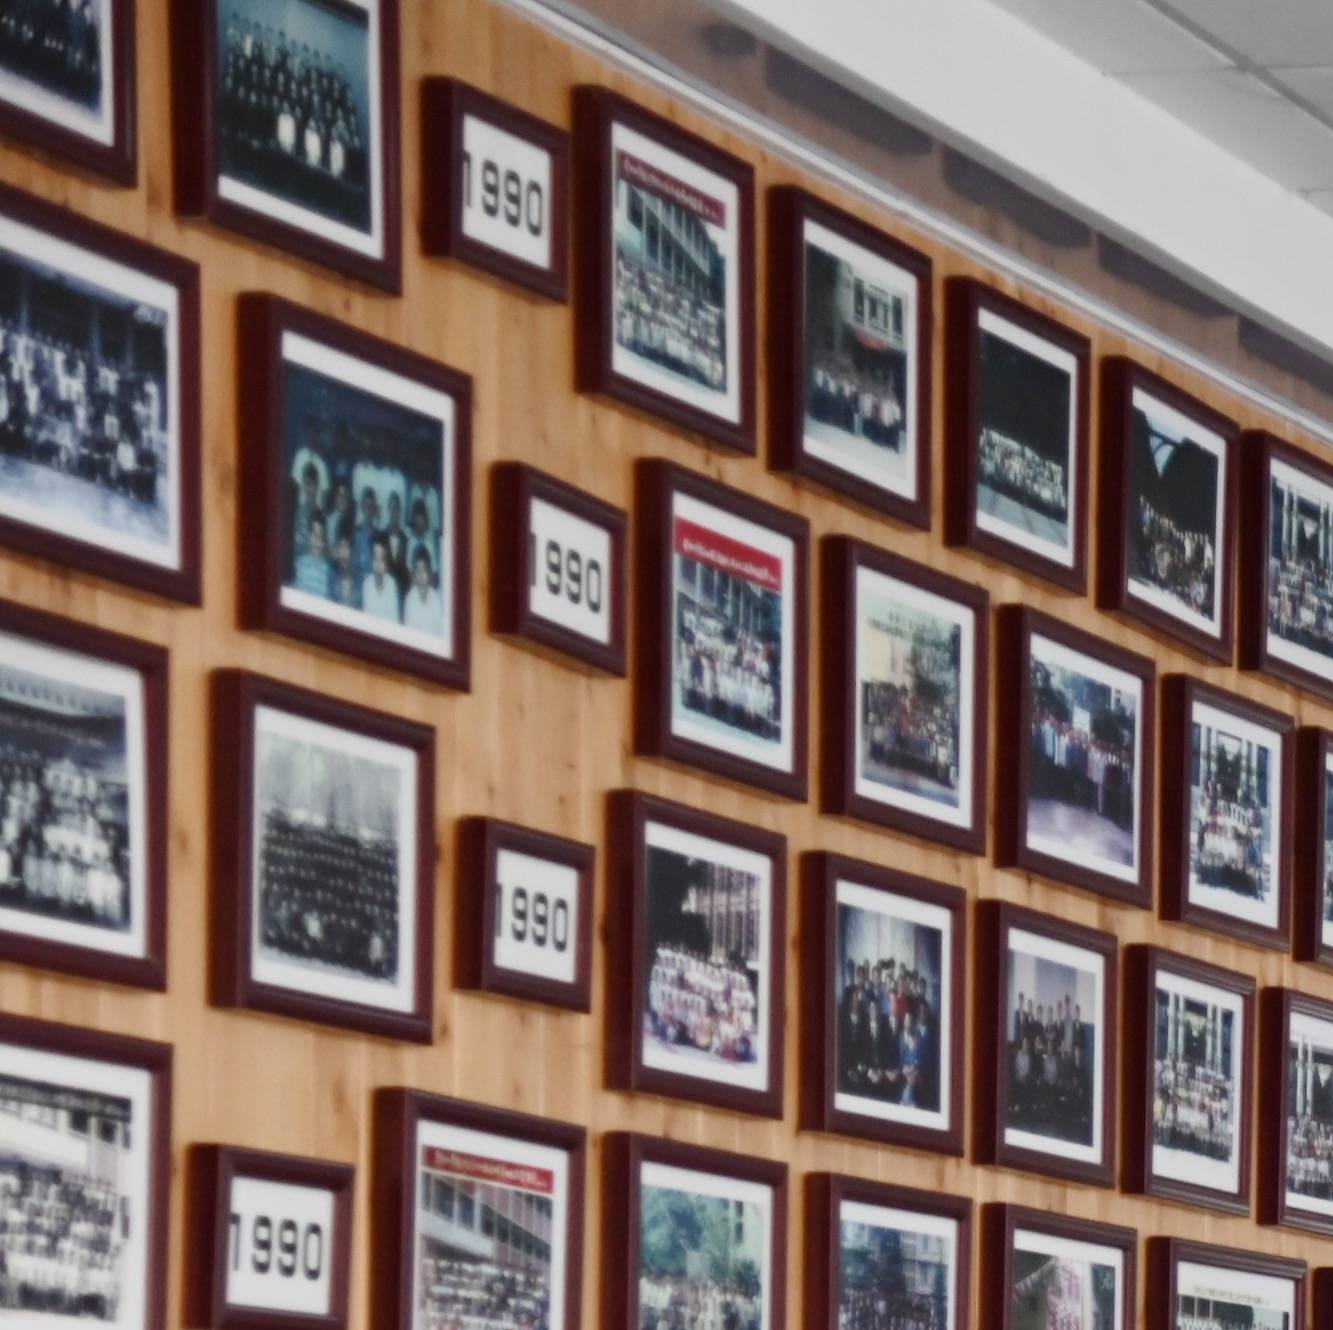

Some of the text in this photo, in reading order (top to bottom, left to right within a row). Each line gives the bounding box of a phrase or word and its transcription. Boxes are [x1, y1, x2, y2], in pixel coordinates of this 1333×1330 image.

[464, 151, 543, 237] 1990
[494, 883, 568, 953] 1990
[230, 1212, 322, 1281] 1990
